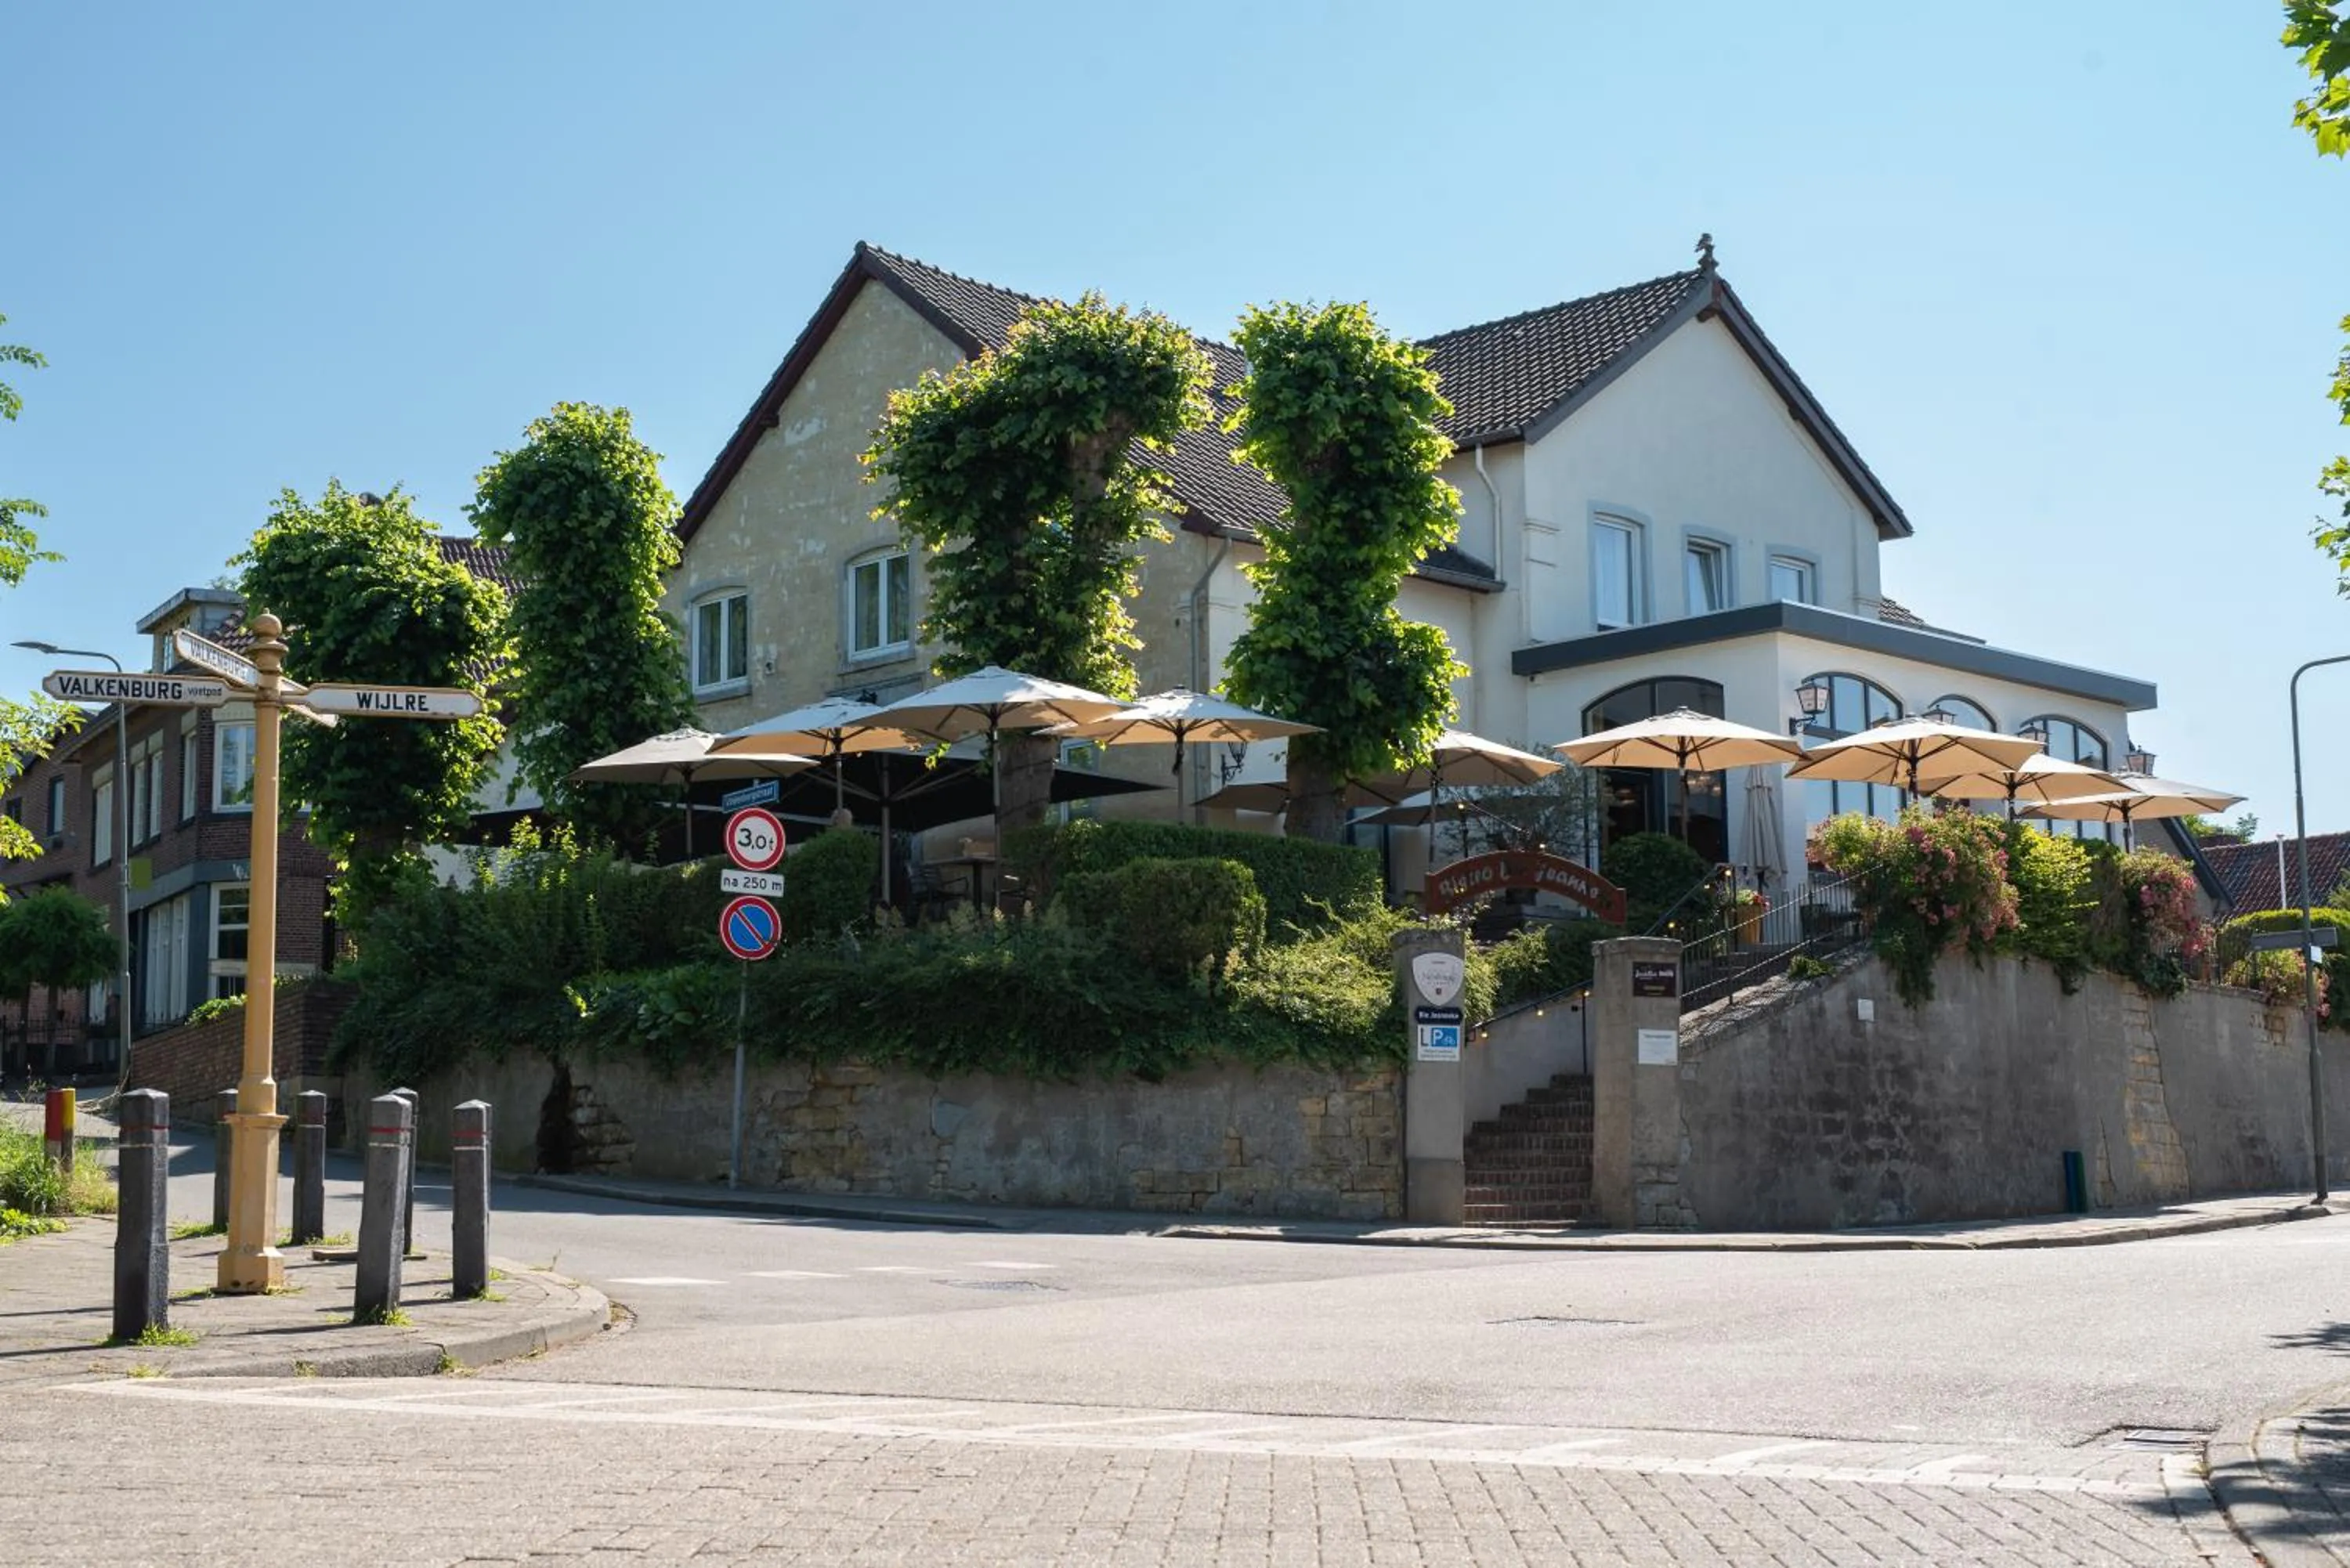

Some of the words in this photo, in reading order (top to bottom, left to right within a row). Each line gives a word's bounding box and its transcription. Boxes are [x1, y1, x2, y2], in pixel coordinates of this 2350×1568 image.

[190, 639, 250, 681] VALKENBURG
[59, 676, 183, 699] VALKENBURG
[356, 692, 429, 711] WIJLRE
[724, 877, 739, 887] na
[743, 877, 767, 890] 250
[772, 881, 782, 891] m
